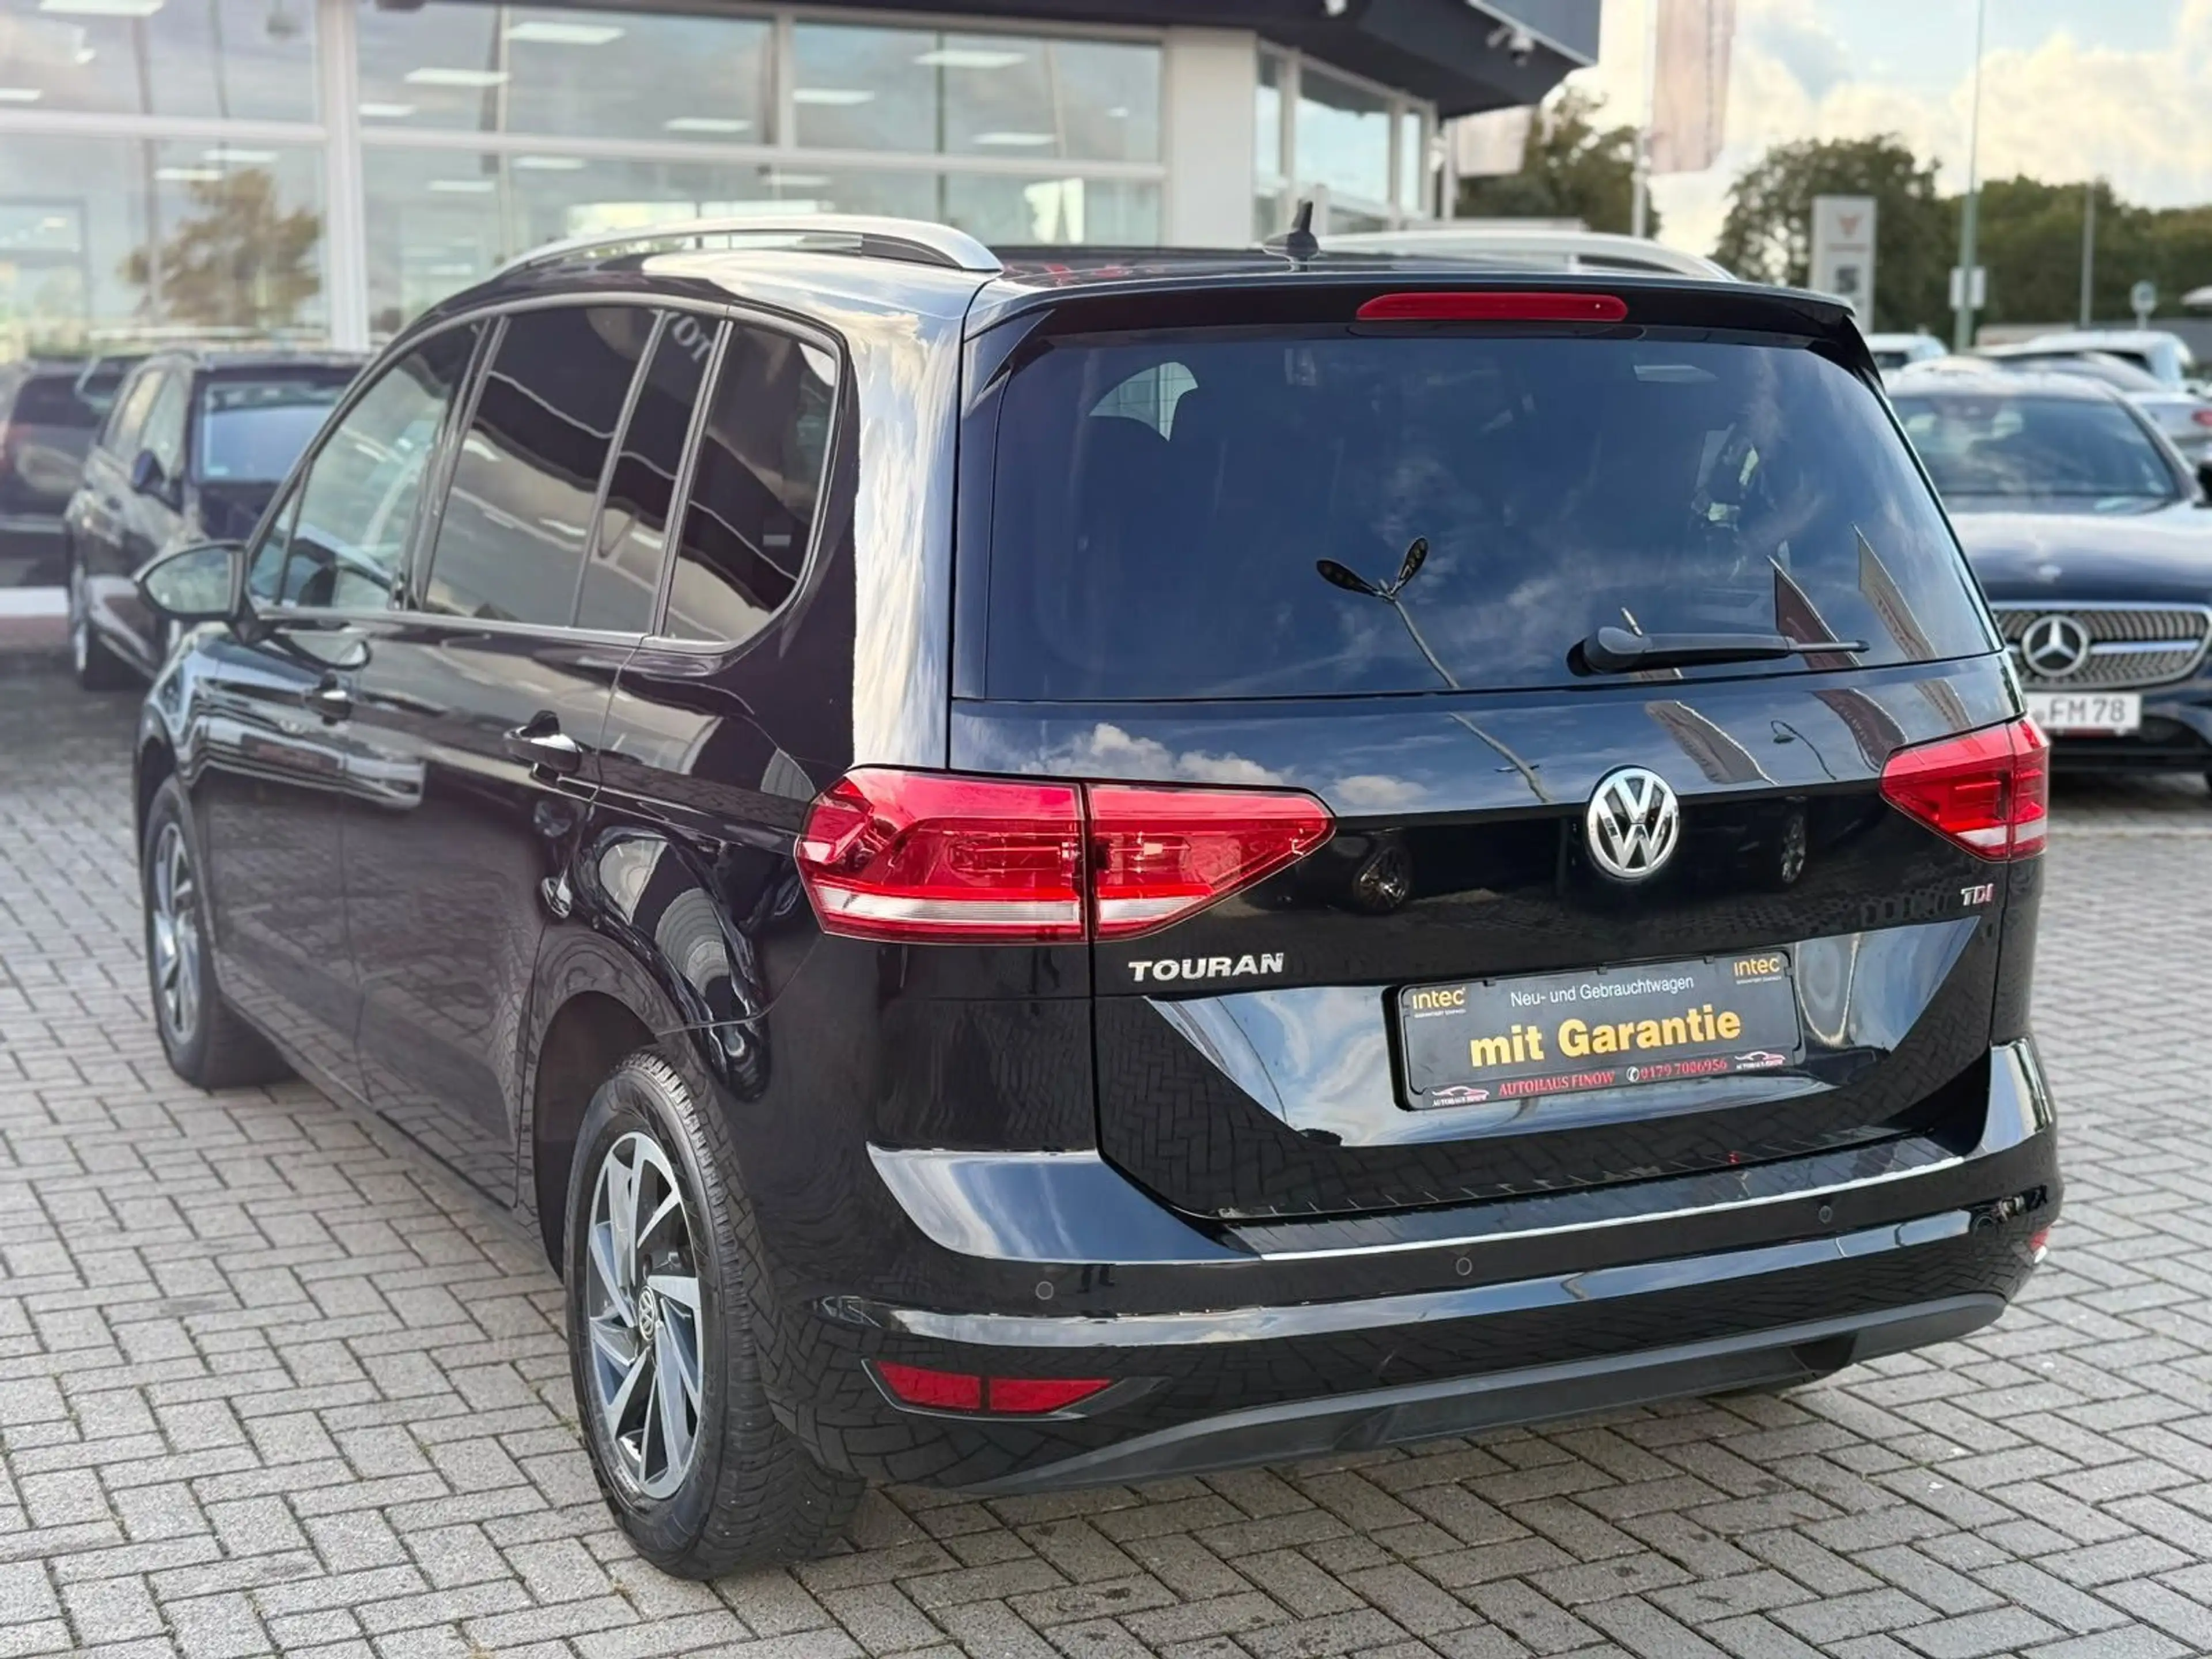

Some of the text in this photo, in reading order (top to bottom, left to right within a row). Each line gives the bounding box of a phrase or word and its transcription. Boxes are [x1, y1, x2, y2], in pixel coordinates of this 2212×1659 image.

[1961, 883, 1994, 906] TDI
[1128, 952, 1284, 982] TOURAN
[1733, 957, 1781, 977] intec
[1412, 988, 1465, 1010] intec
[1510, 976, 1695, 1007] Neu- und Gebrauchtwagen
[1469, 1004, 1741, 1067] mit Garantie
[1499, 1070, 1616, 1096] AUTOHAUS FINOW
